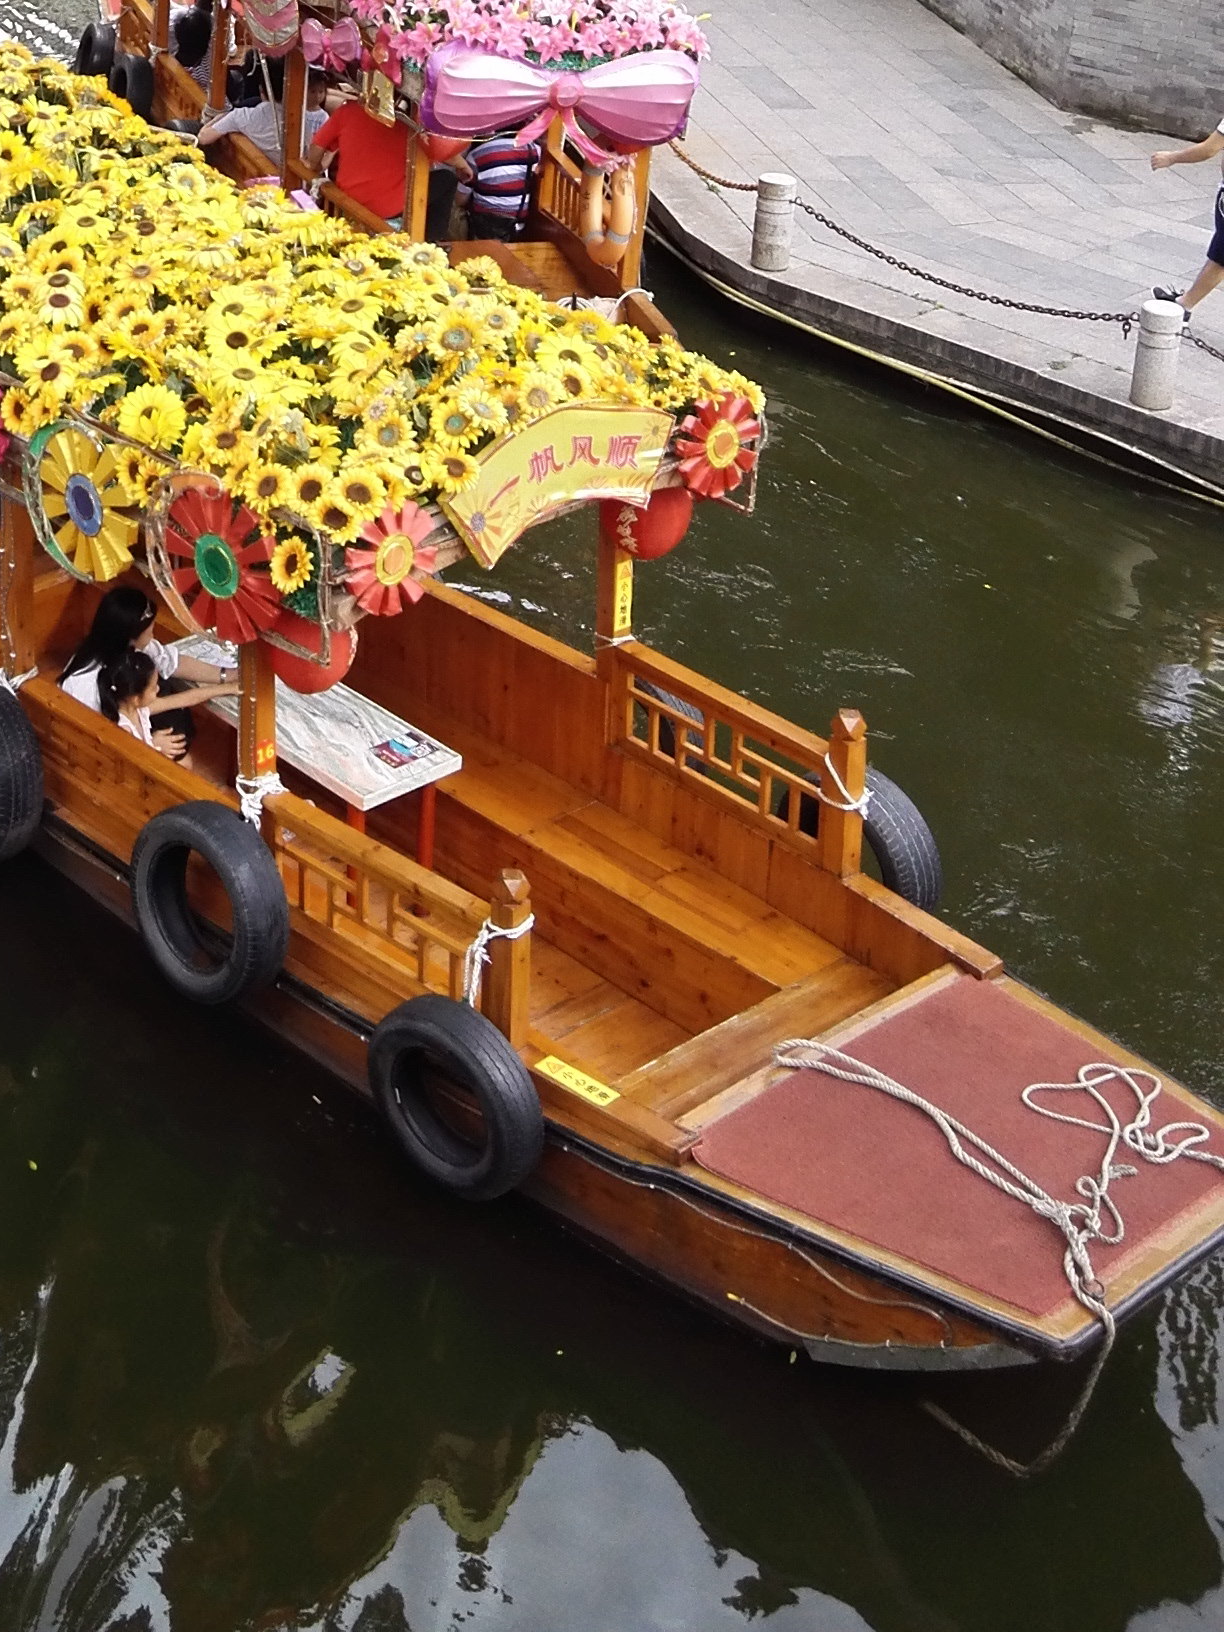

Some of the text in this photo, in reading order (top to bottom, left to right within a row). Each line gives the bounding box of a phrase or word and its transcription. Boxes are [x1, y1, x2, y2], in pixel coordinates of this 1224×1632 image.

[488, 435, 642, 509] 一帆风顺
[256, 743, 275, 764] 16
